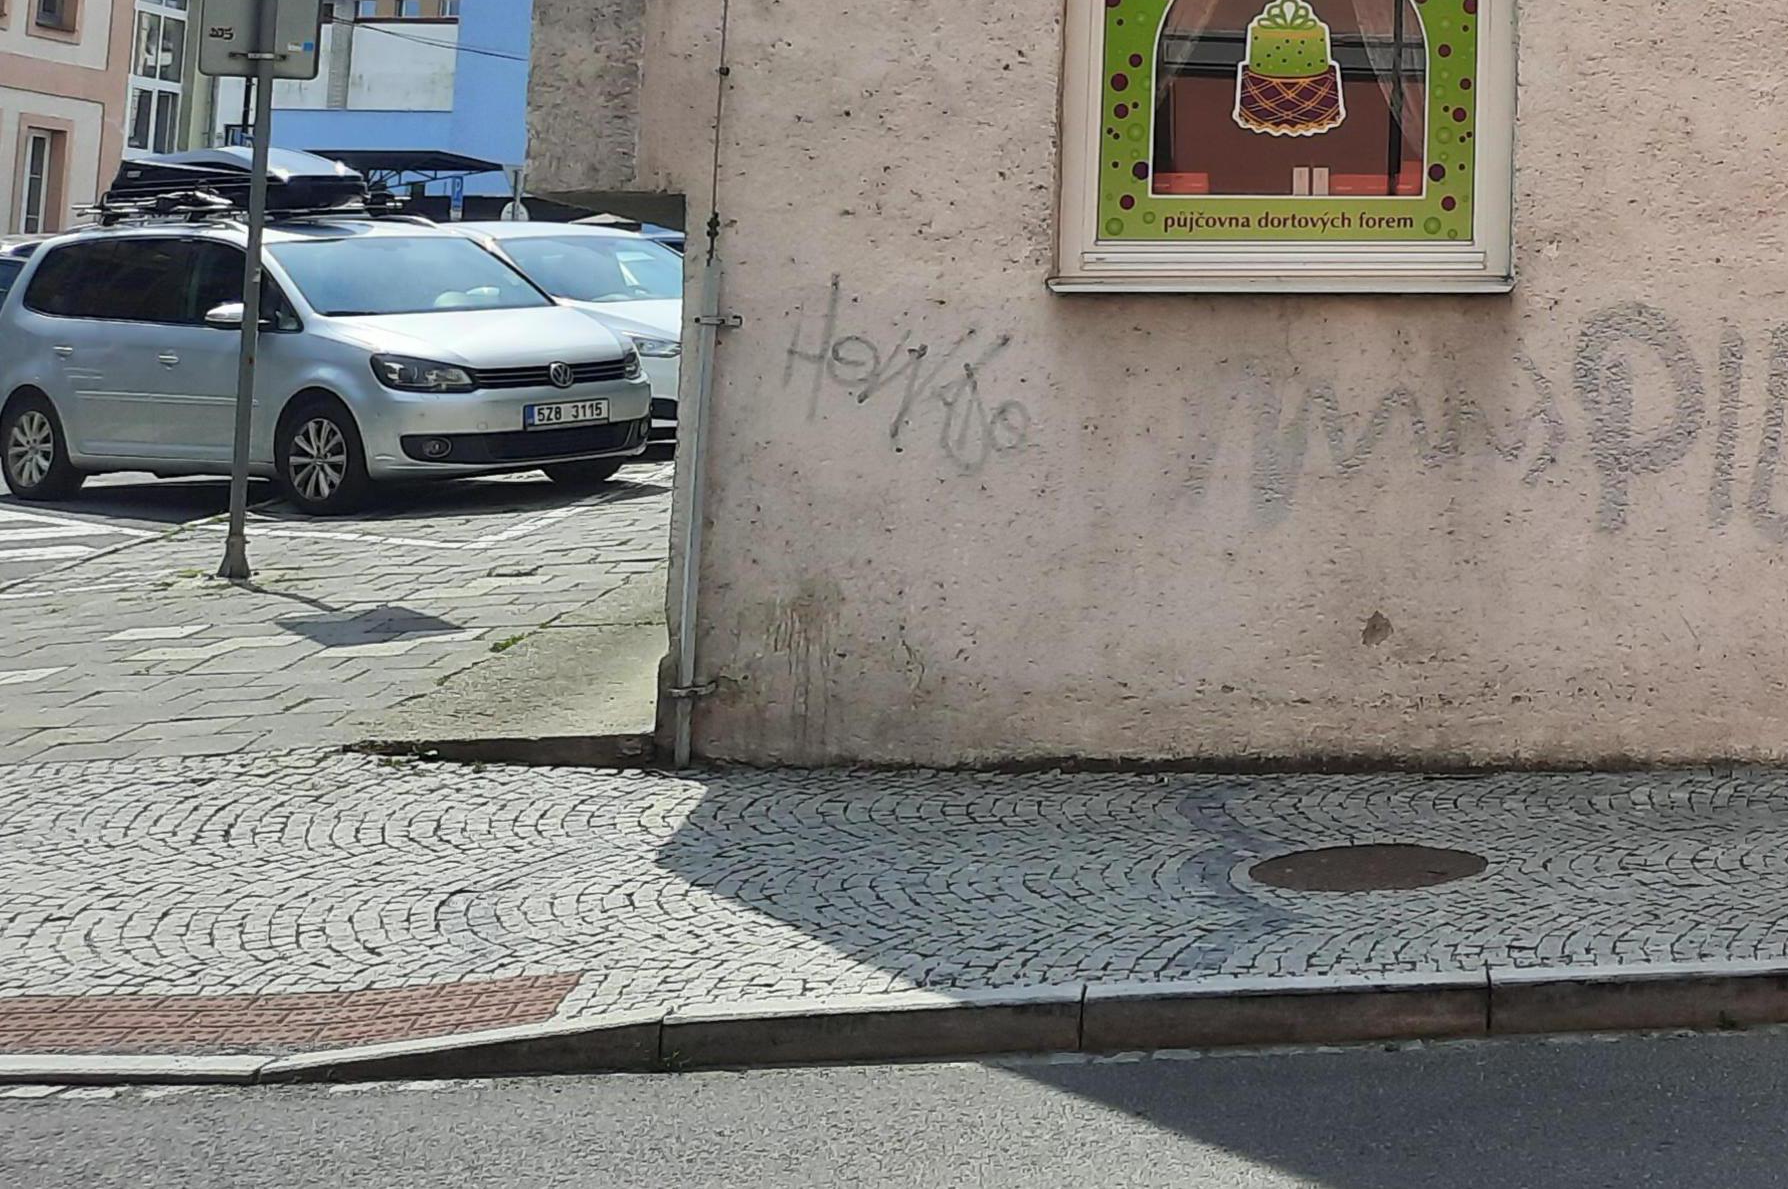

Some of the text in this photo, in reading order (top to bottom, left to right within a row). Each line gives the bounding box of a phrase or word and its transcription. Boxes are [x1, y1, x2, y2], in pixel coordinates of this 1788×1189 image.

[1163, 210, 1414, 233] půjčovna dortových forem
[537, 402, 603, 422] 5Z8 3115
